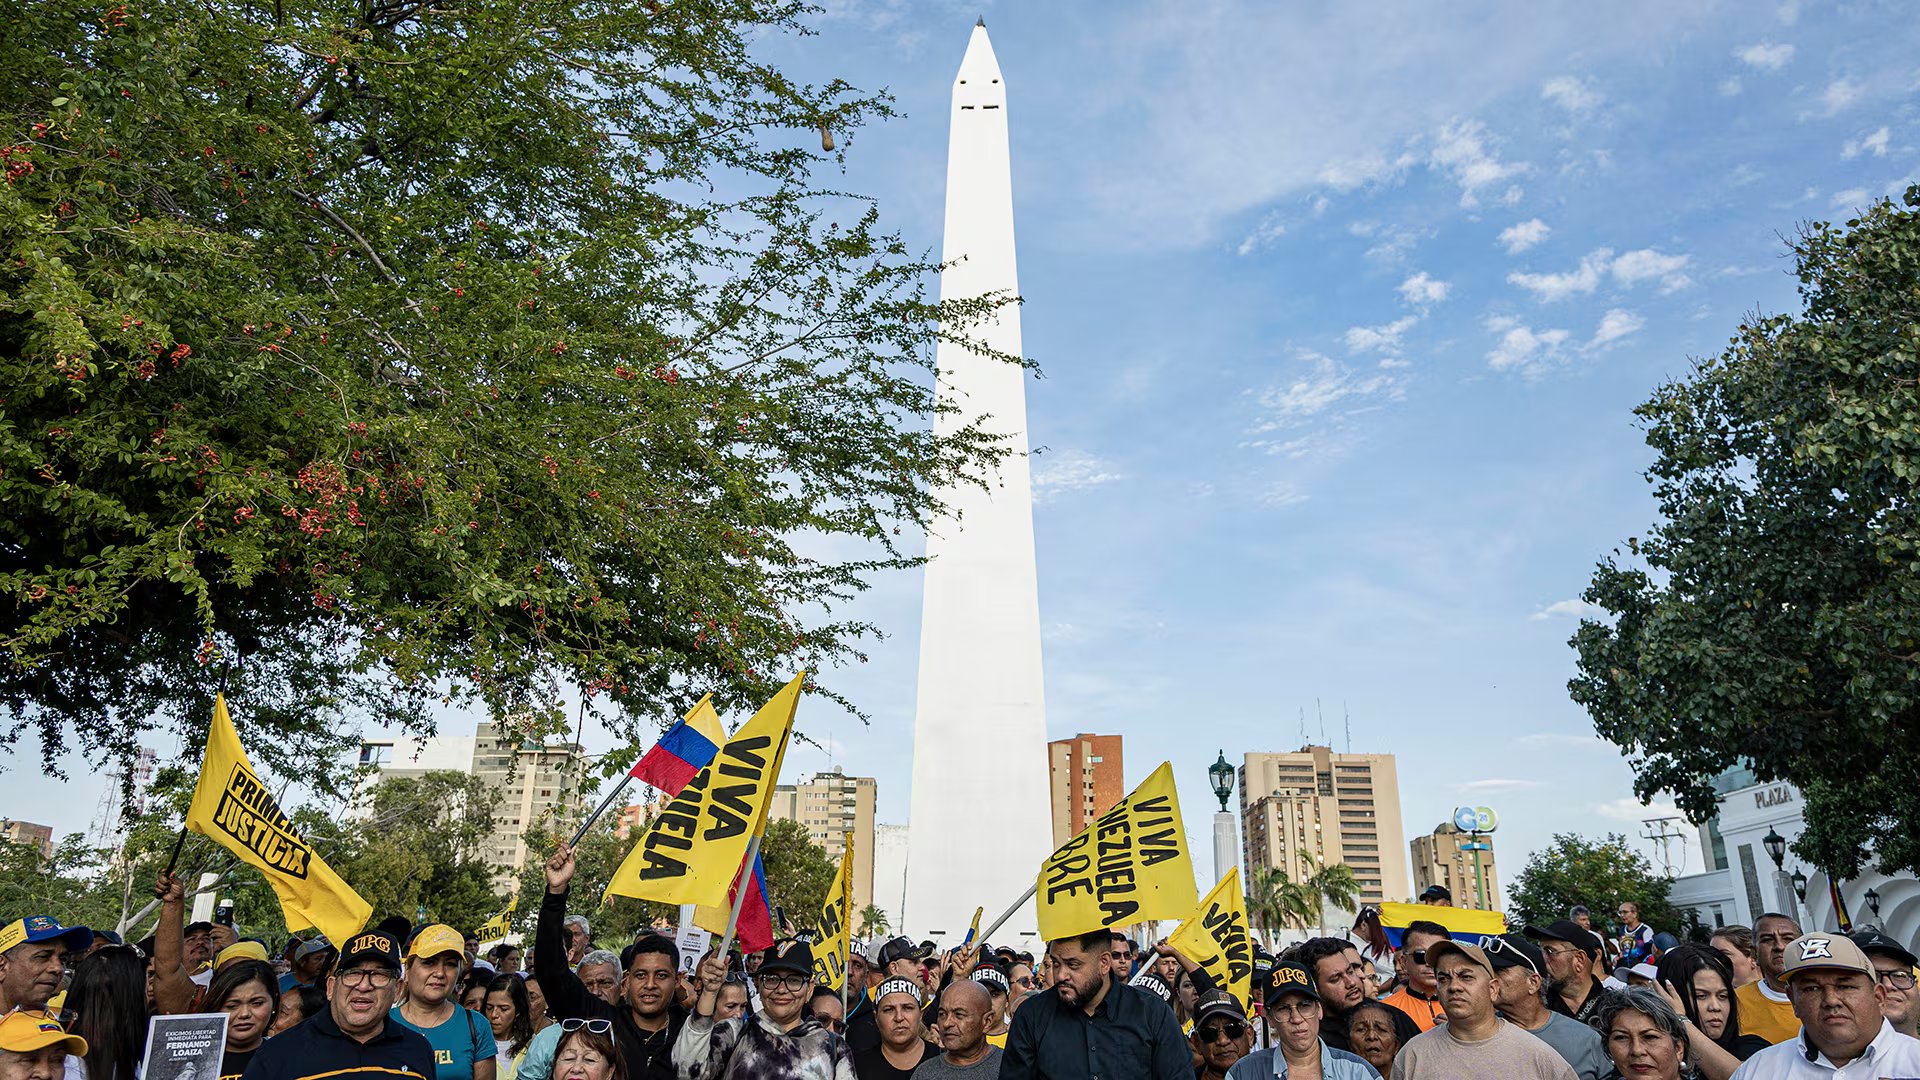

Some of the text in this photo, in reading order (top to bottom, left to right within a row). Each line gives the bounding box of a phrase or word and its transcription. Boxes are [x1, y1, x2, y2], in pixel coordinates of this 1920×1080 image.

[703, 736, 771, 841] VIVA
[1754, 785, 1793, 809] PLAZA
[216, 795, 305, 875] JUSTICIA
[1133, 795, 1179, 867] VIVA
[166, 1040, 211, 1050] FERNANDO
[172, 1048, 203, 1057] LOAIZA
